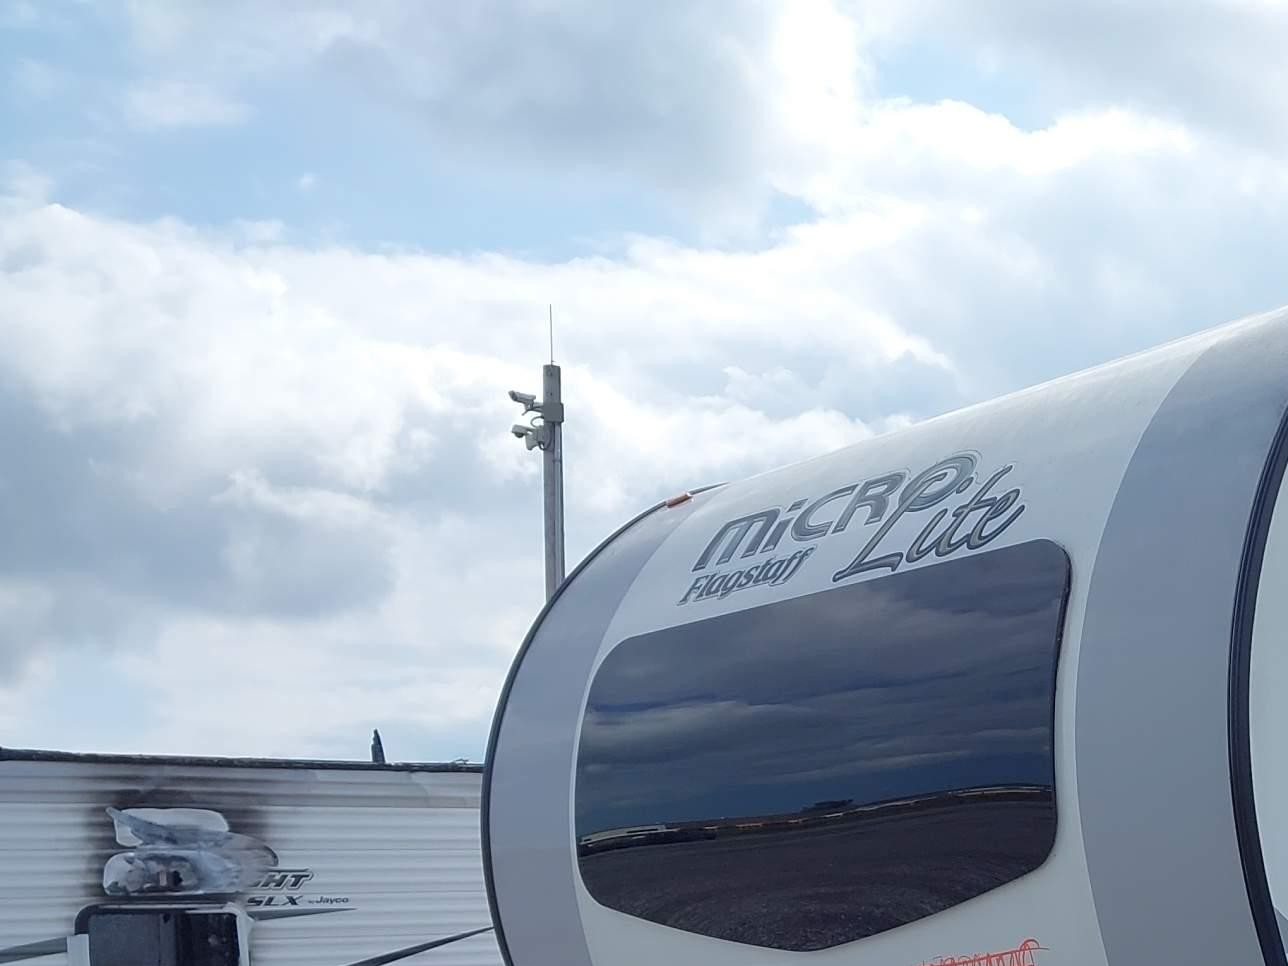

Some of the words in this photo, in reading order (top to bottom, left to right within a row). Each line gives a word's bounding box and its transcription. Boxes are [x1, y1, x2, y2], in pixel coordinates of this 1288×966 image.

[832, 464, 1026, 583] Lite
[678, 545, 816, 606] Flagstaff
[247, 895, 303, 907] SLX
[315, 895, 350, 905] Jayco
